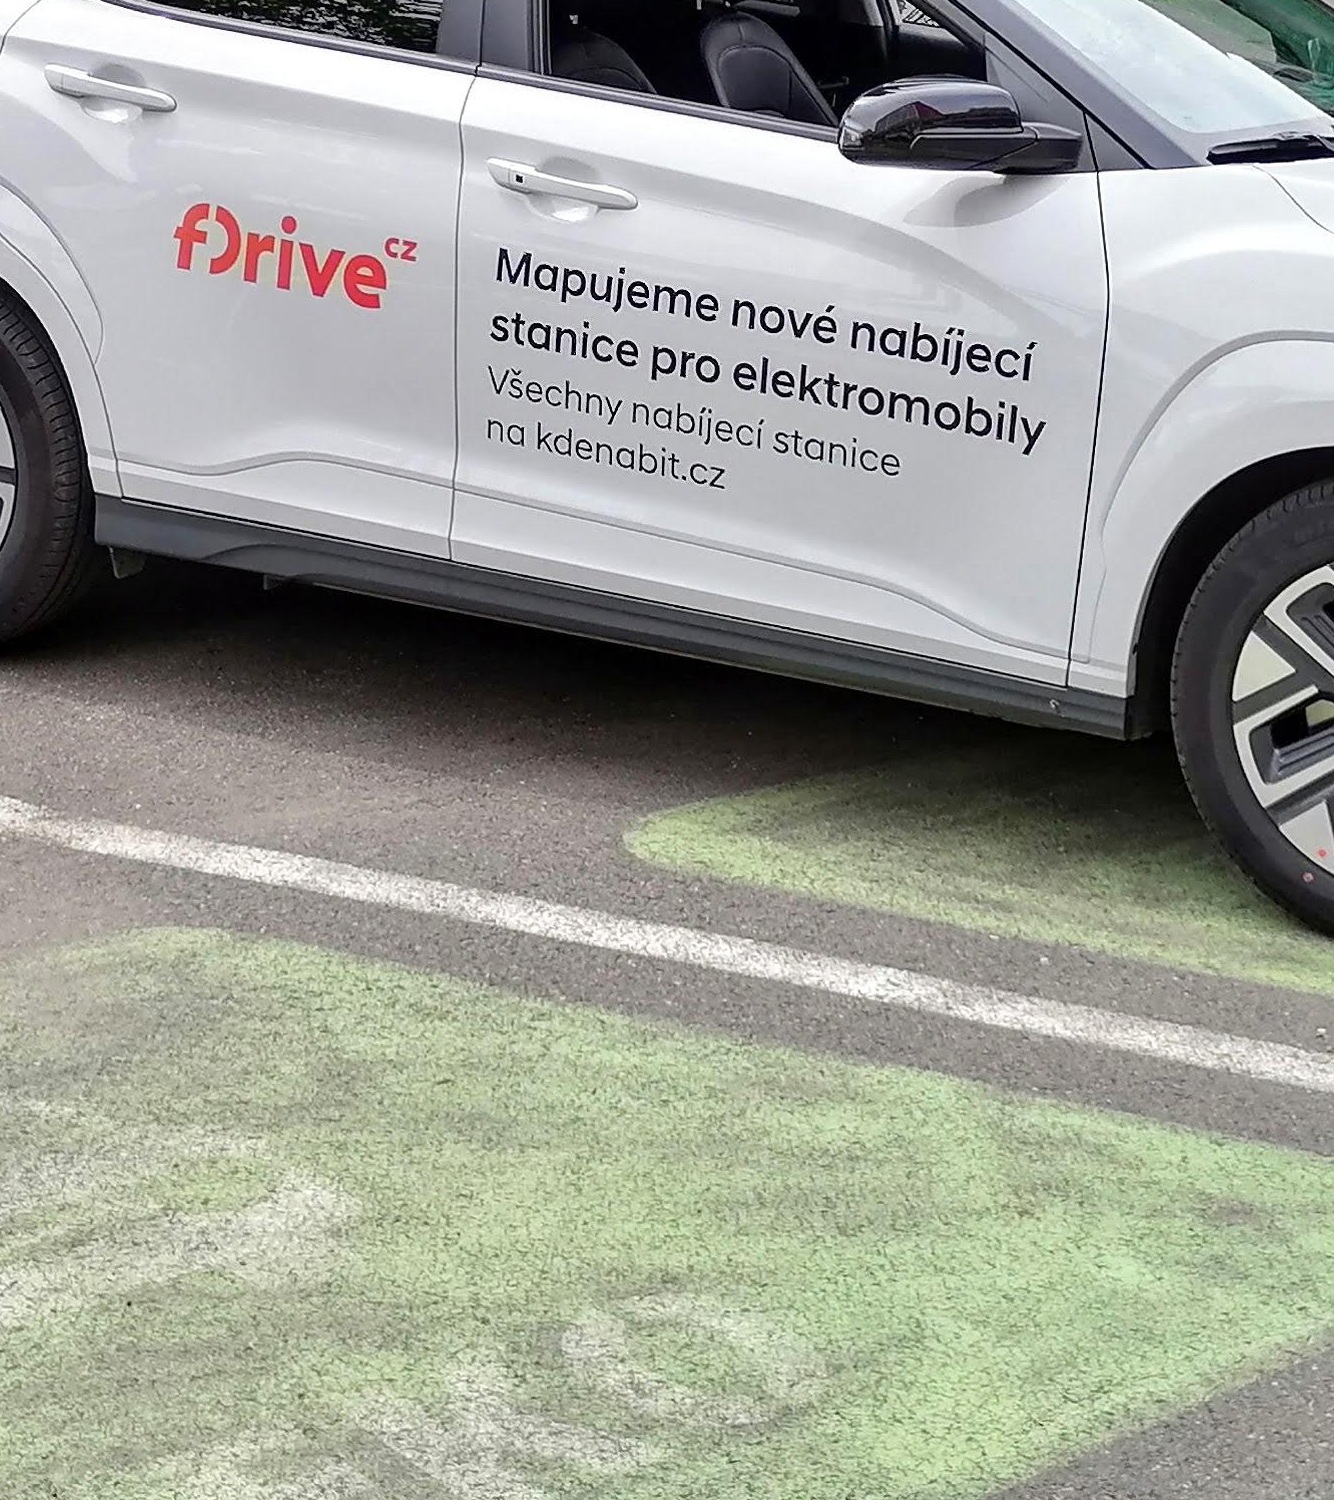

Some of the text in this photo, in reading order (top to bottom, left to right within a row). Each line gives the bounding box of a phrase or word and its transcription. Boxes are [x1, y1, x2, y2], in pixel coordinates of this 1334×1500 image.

[495, 247, 1039, 381] Mapujeme nové nabíjecí
[486, 364, 902, 476] Všechny nabíjecí stanice
[489, 312, 1047, 456] stanice pro elektromobily
[486, 418, 727, 490] na kdenabit.cz
